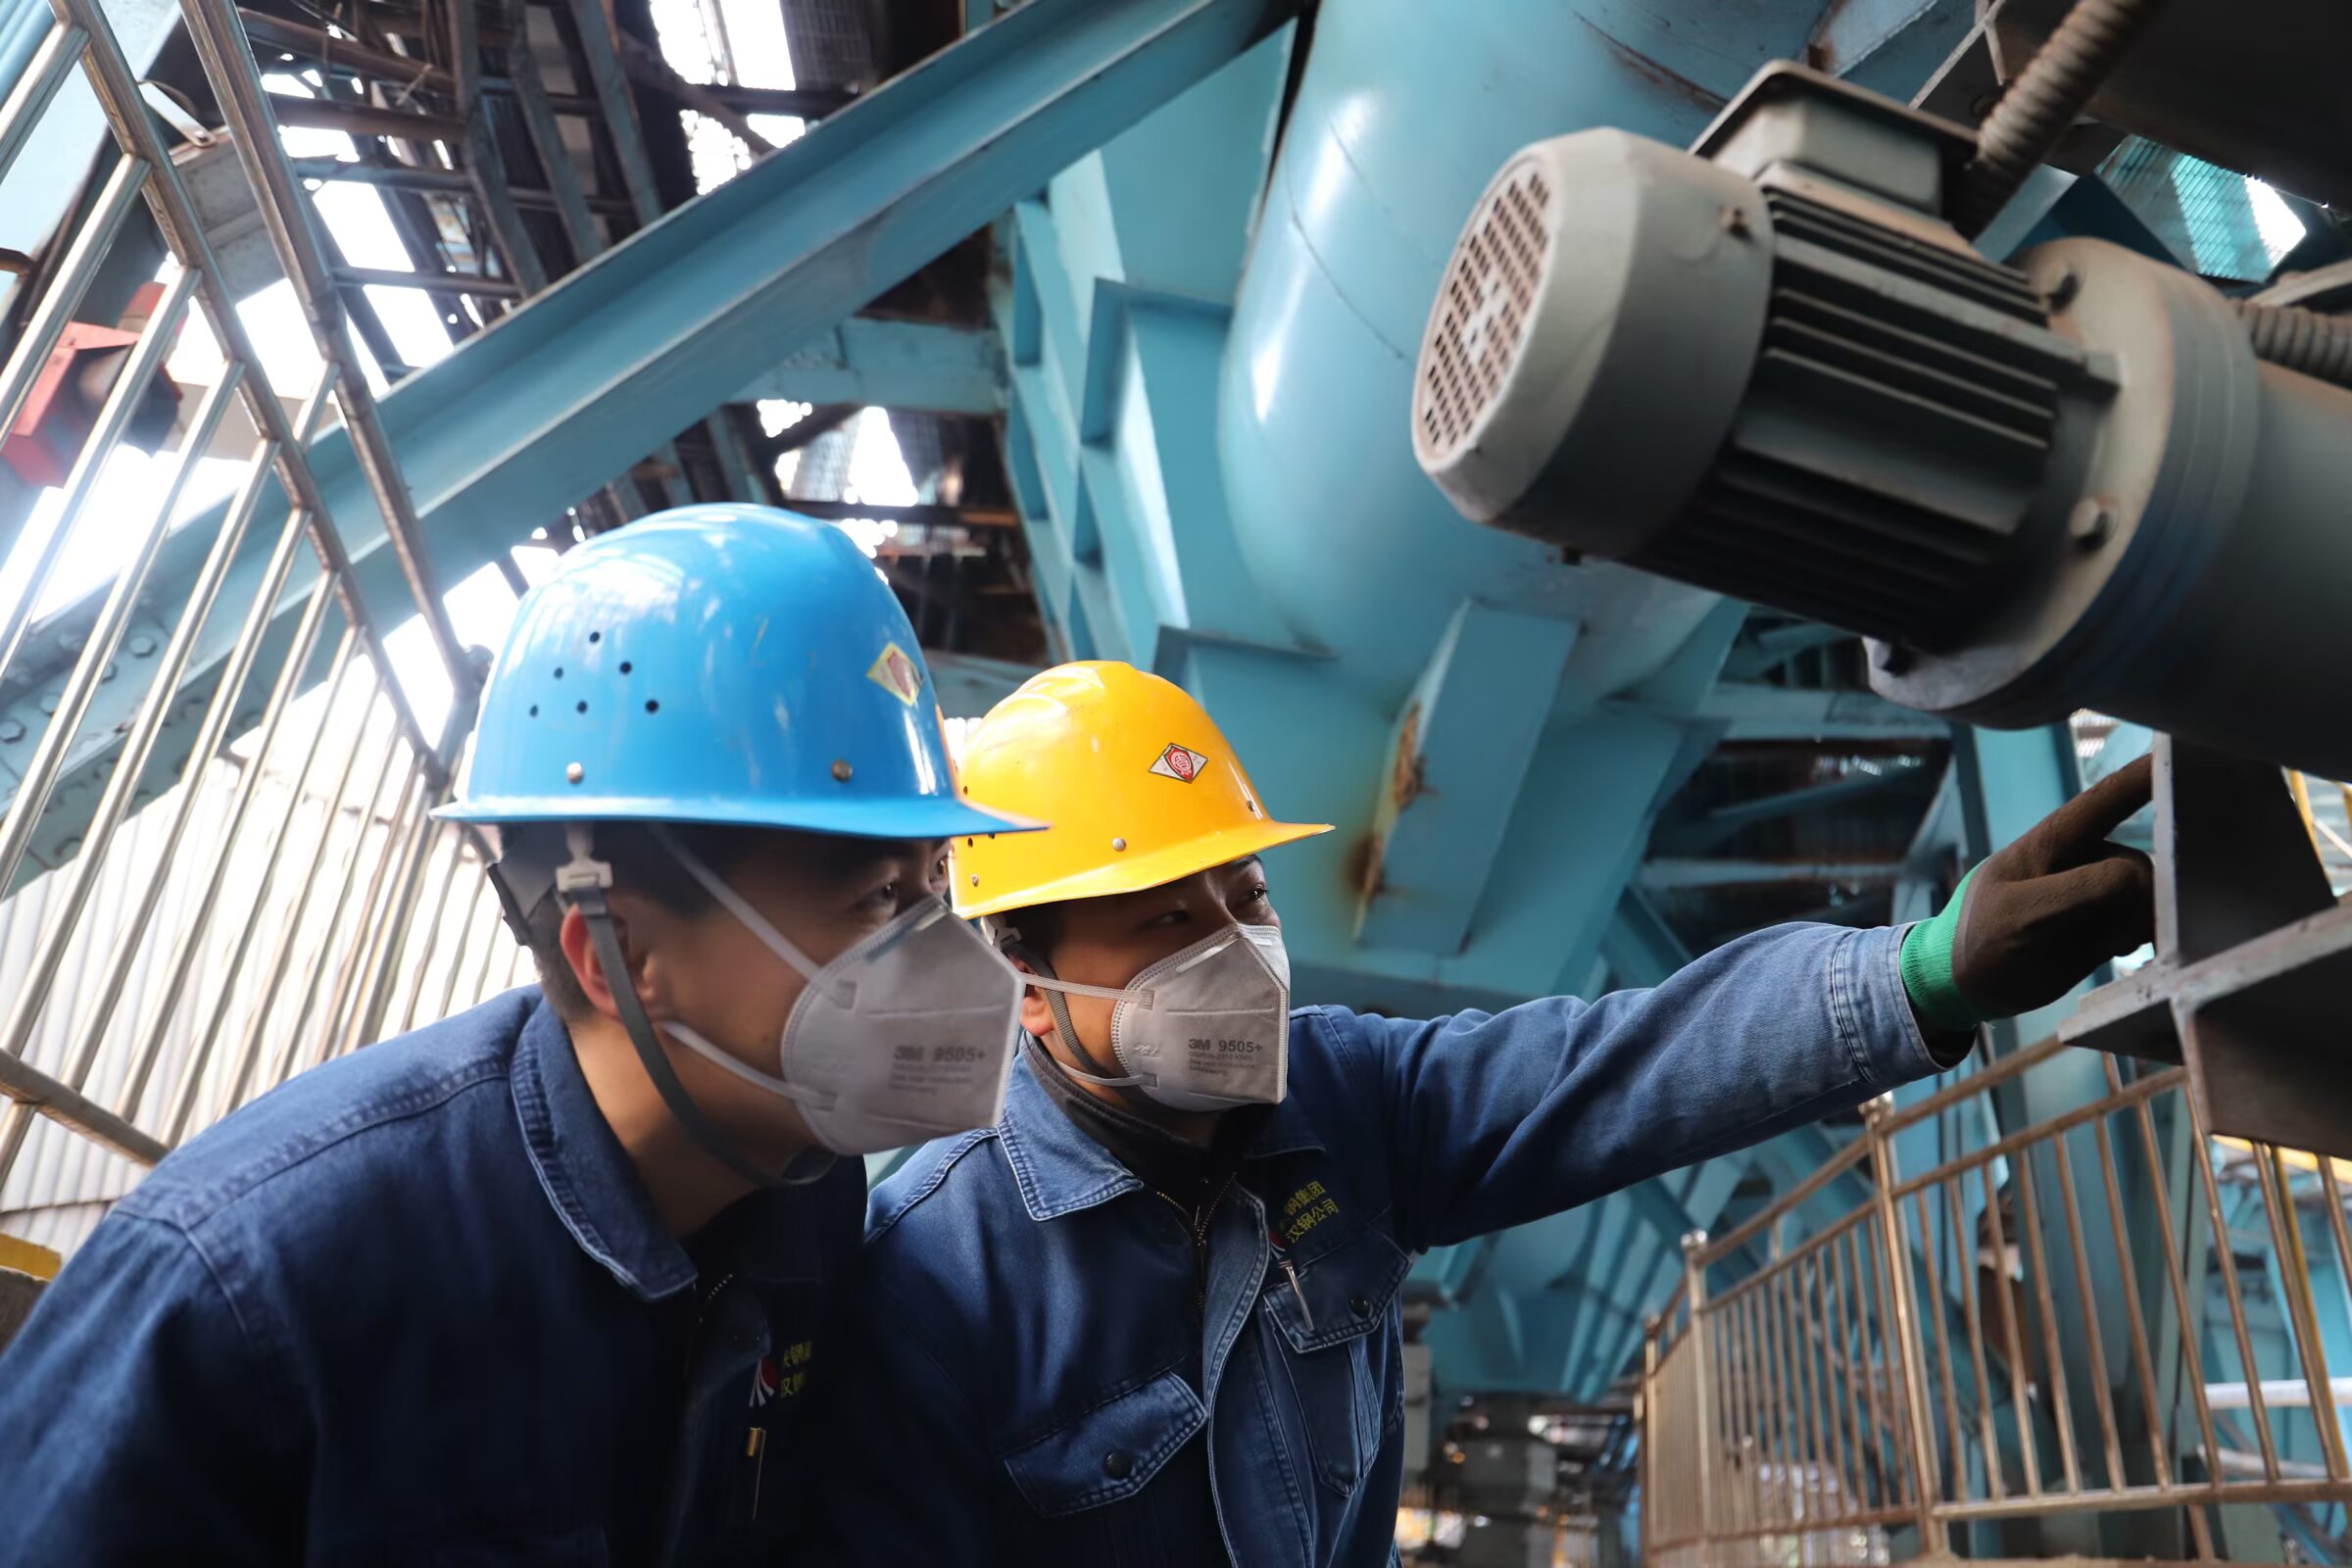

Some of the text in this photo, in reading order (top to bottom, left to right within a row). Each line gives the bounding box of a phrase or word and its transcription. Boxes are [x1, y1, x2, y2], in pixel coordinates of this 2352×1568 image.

[1188, 1039, 1263, 1054] 3M 9505+
[1280, 1182, 1326, 1225] 钢集团
[1285, 1199, 1340, 1244] 汉钢公司
